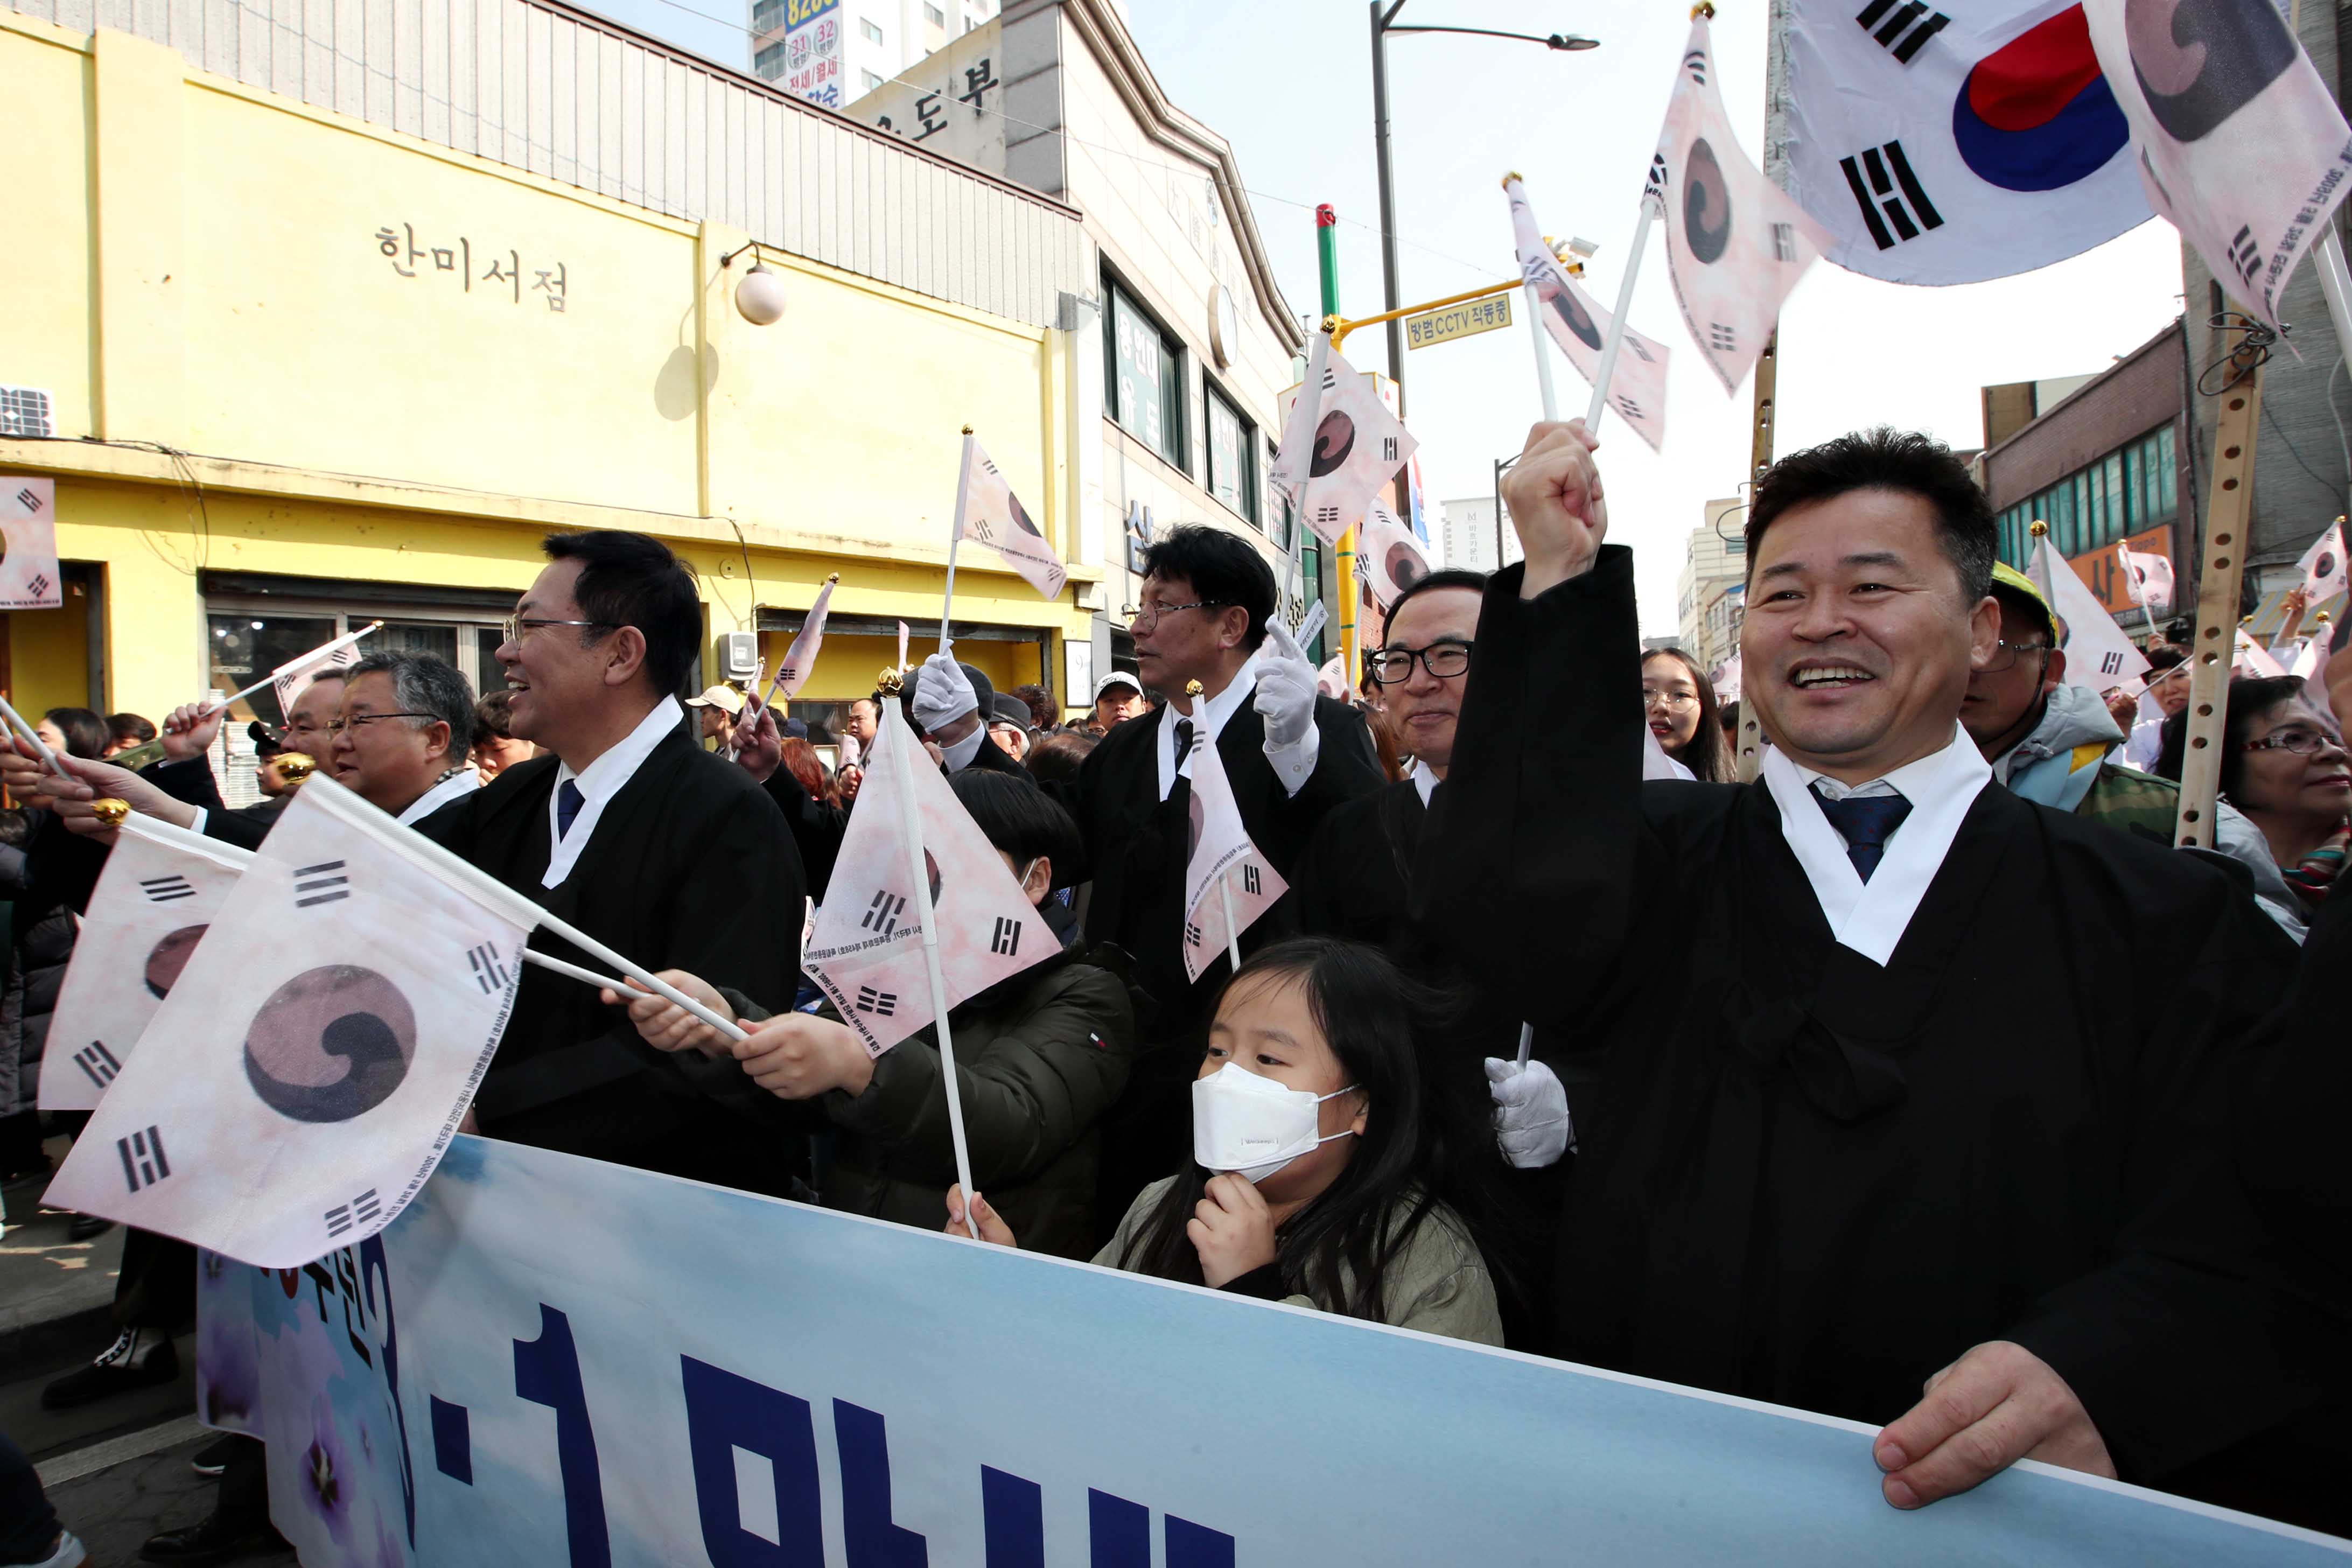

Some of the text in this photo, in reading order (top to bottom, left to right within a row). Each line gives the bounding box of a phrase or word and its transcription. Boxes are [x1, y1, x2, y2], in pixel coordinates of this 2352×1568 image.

[818, 20, 834, 42] 32
[792, 34, 806, 57] 31
[375, 222, 566, 312] 한미서점
